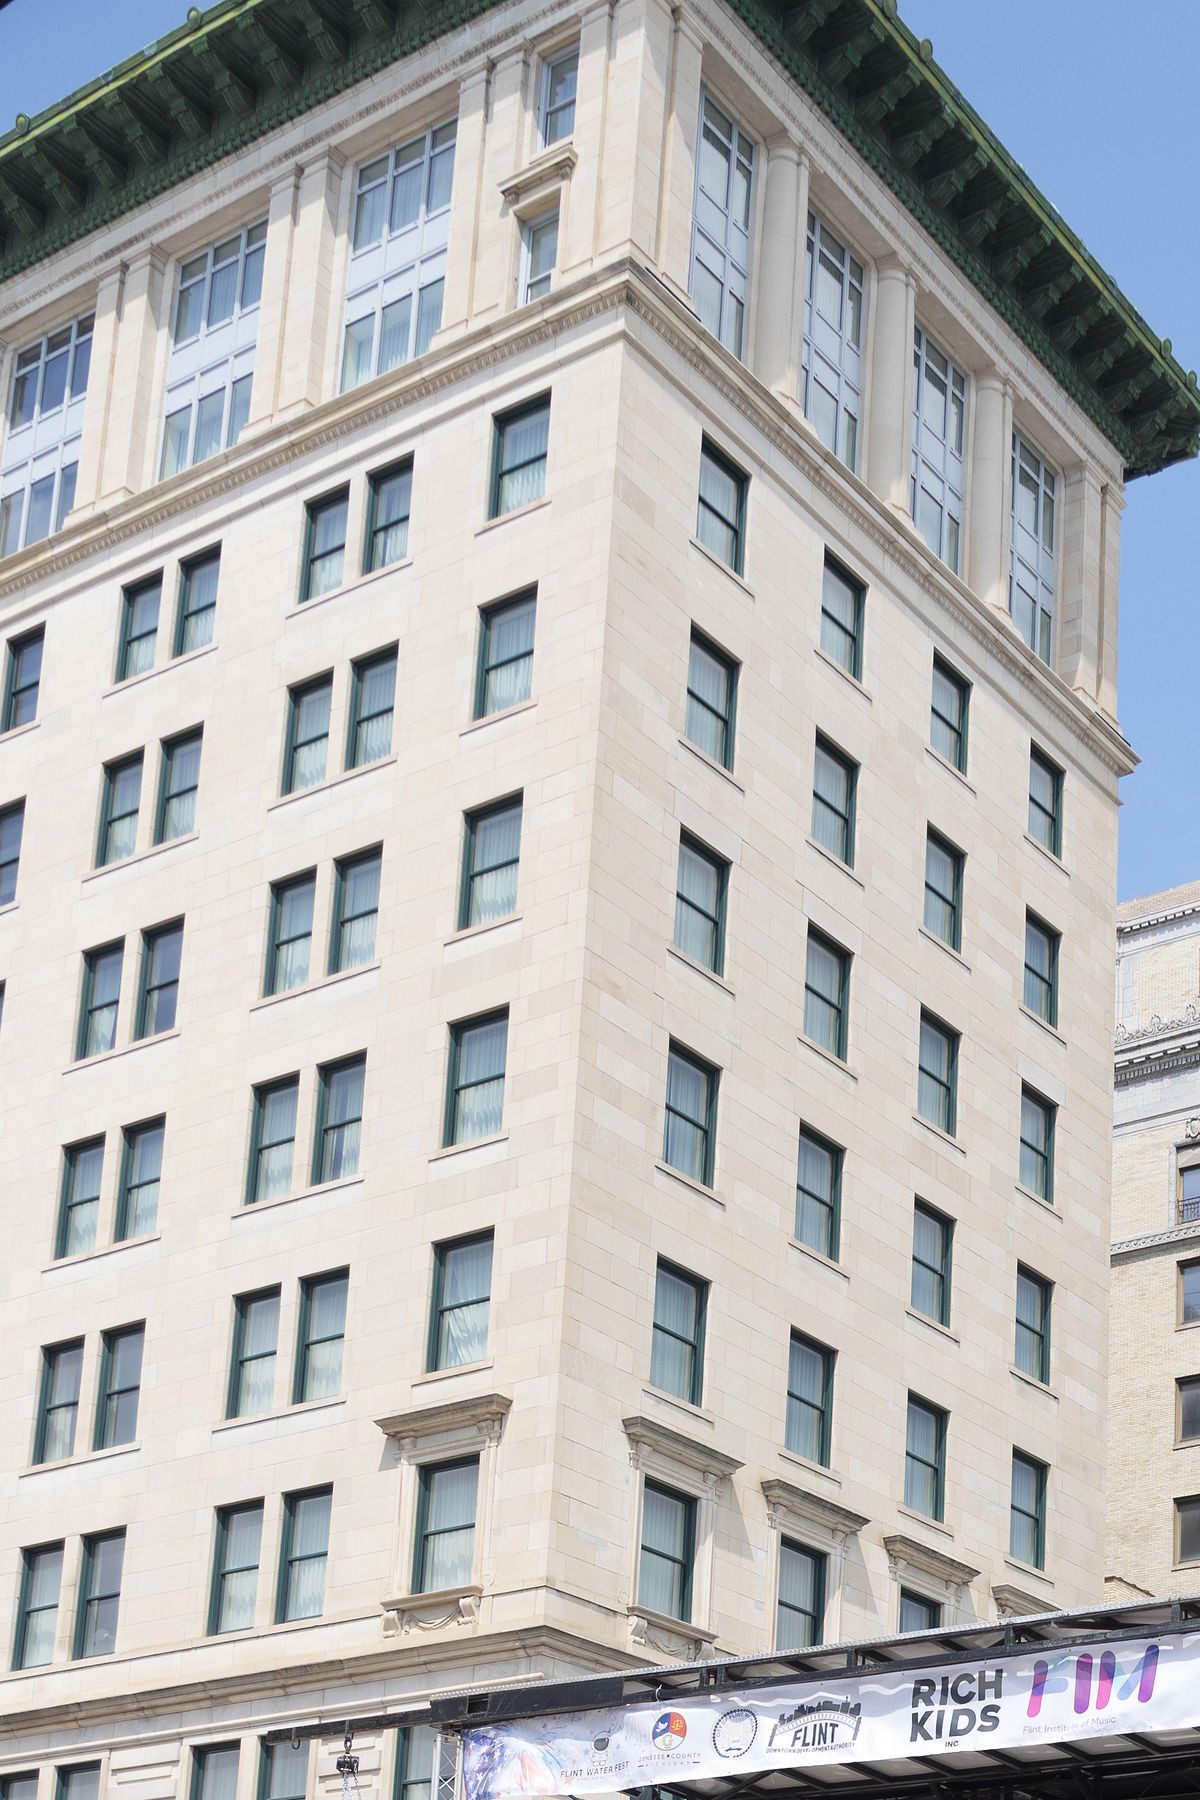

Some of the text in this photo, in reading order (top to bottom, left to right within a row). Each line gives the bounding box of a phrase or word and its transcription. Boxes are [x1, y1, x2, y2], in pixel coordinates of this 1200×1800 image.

[911, 1669, 1004, 1708] RICH
[1027, 1644, 1160, 1718] FIM
[791, 1722, 839, 1747] FLINT
[910, 1704, 1002, 1742] KIDS
[1022, 1725, 1041, 1734] Flint
[1091, 1715, 1116, 1726] Music
[944, 1740, 959, 1748] INC
[560, 1770, 583, 1778] FLINT
[586, 1766, 613, 1776] WATER
[614, 1760, 629, 1771] FEST
